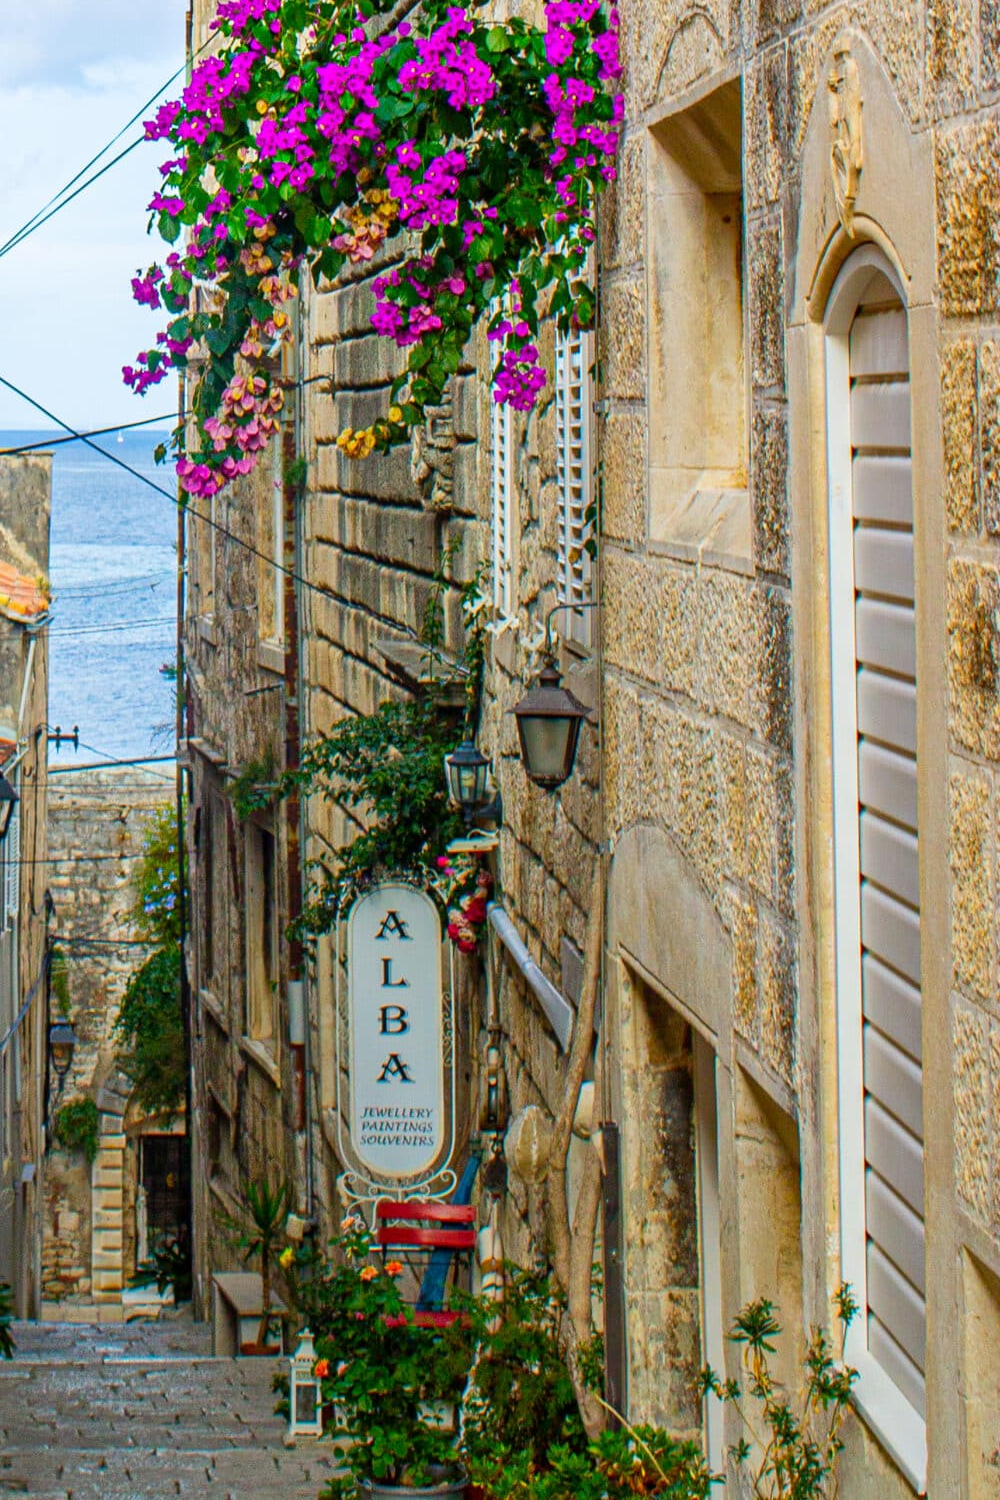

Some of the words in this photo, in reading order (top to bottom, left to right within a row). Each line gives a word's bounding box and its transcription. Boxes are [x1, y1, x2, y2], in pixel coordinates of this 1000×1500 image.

[374, 910, 415, 1083] ALBA
[361, 1107, 433, 1118] JEWELLERY
[362, 1121, 433, 1133] PAINTINGS
[360, 1135, 434, 1146] SOUVENIRS
